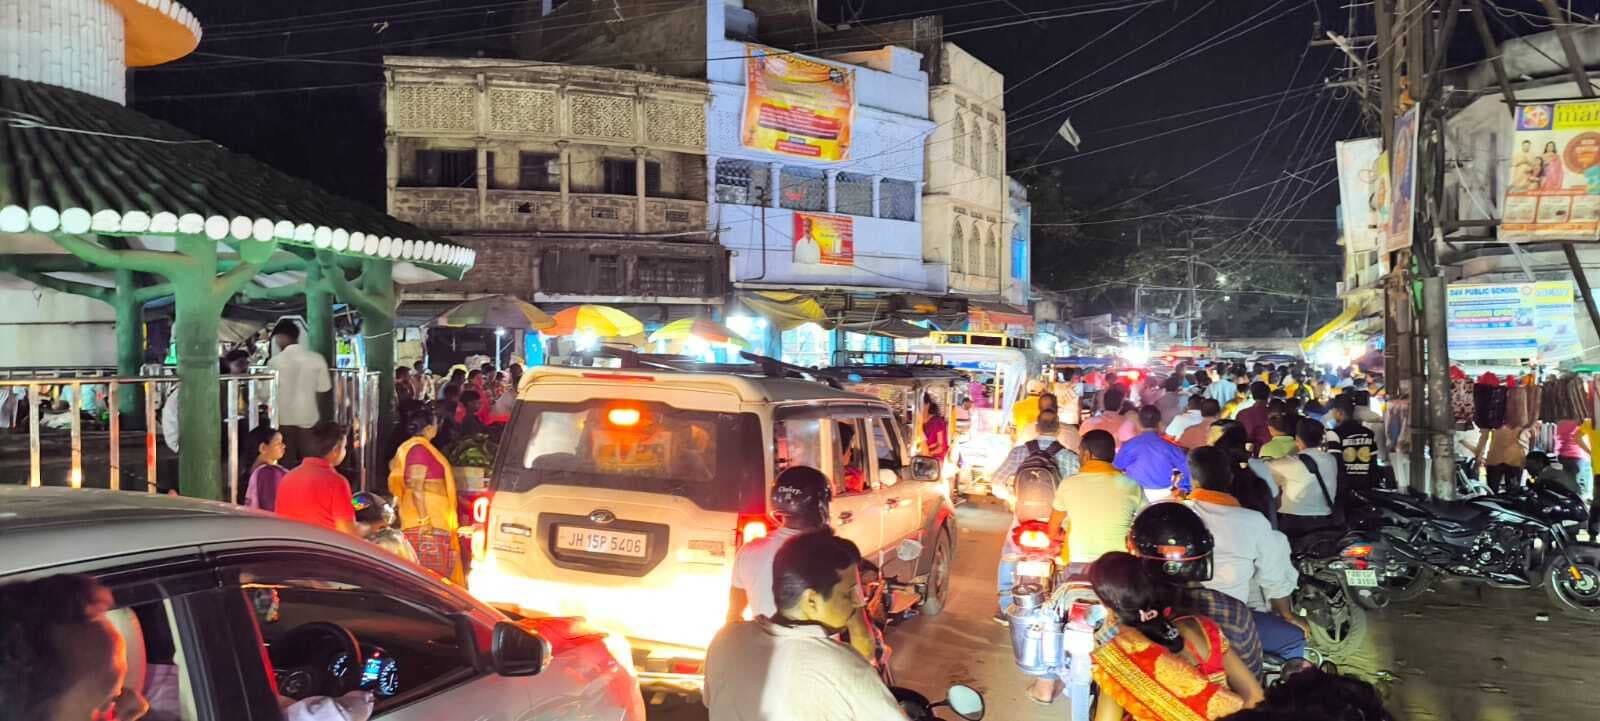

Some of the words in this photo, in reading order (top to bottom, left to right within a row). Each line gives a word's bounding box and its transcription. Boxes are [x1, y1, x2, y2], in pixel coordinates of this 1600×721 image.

[568, 532, 584, 547] JH
[586, 534, 607, 550] 15P
[610, 539, 641, 553] 5406
